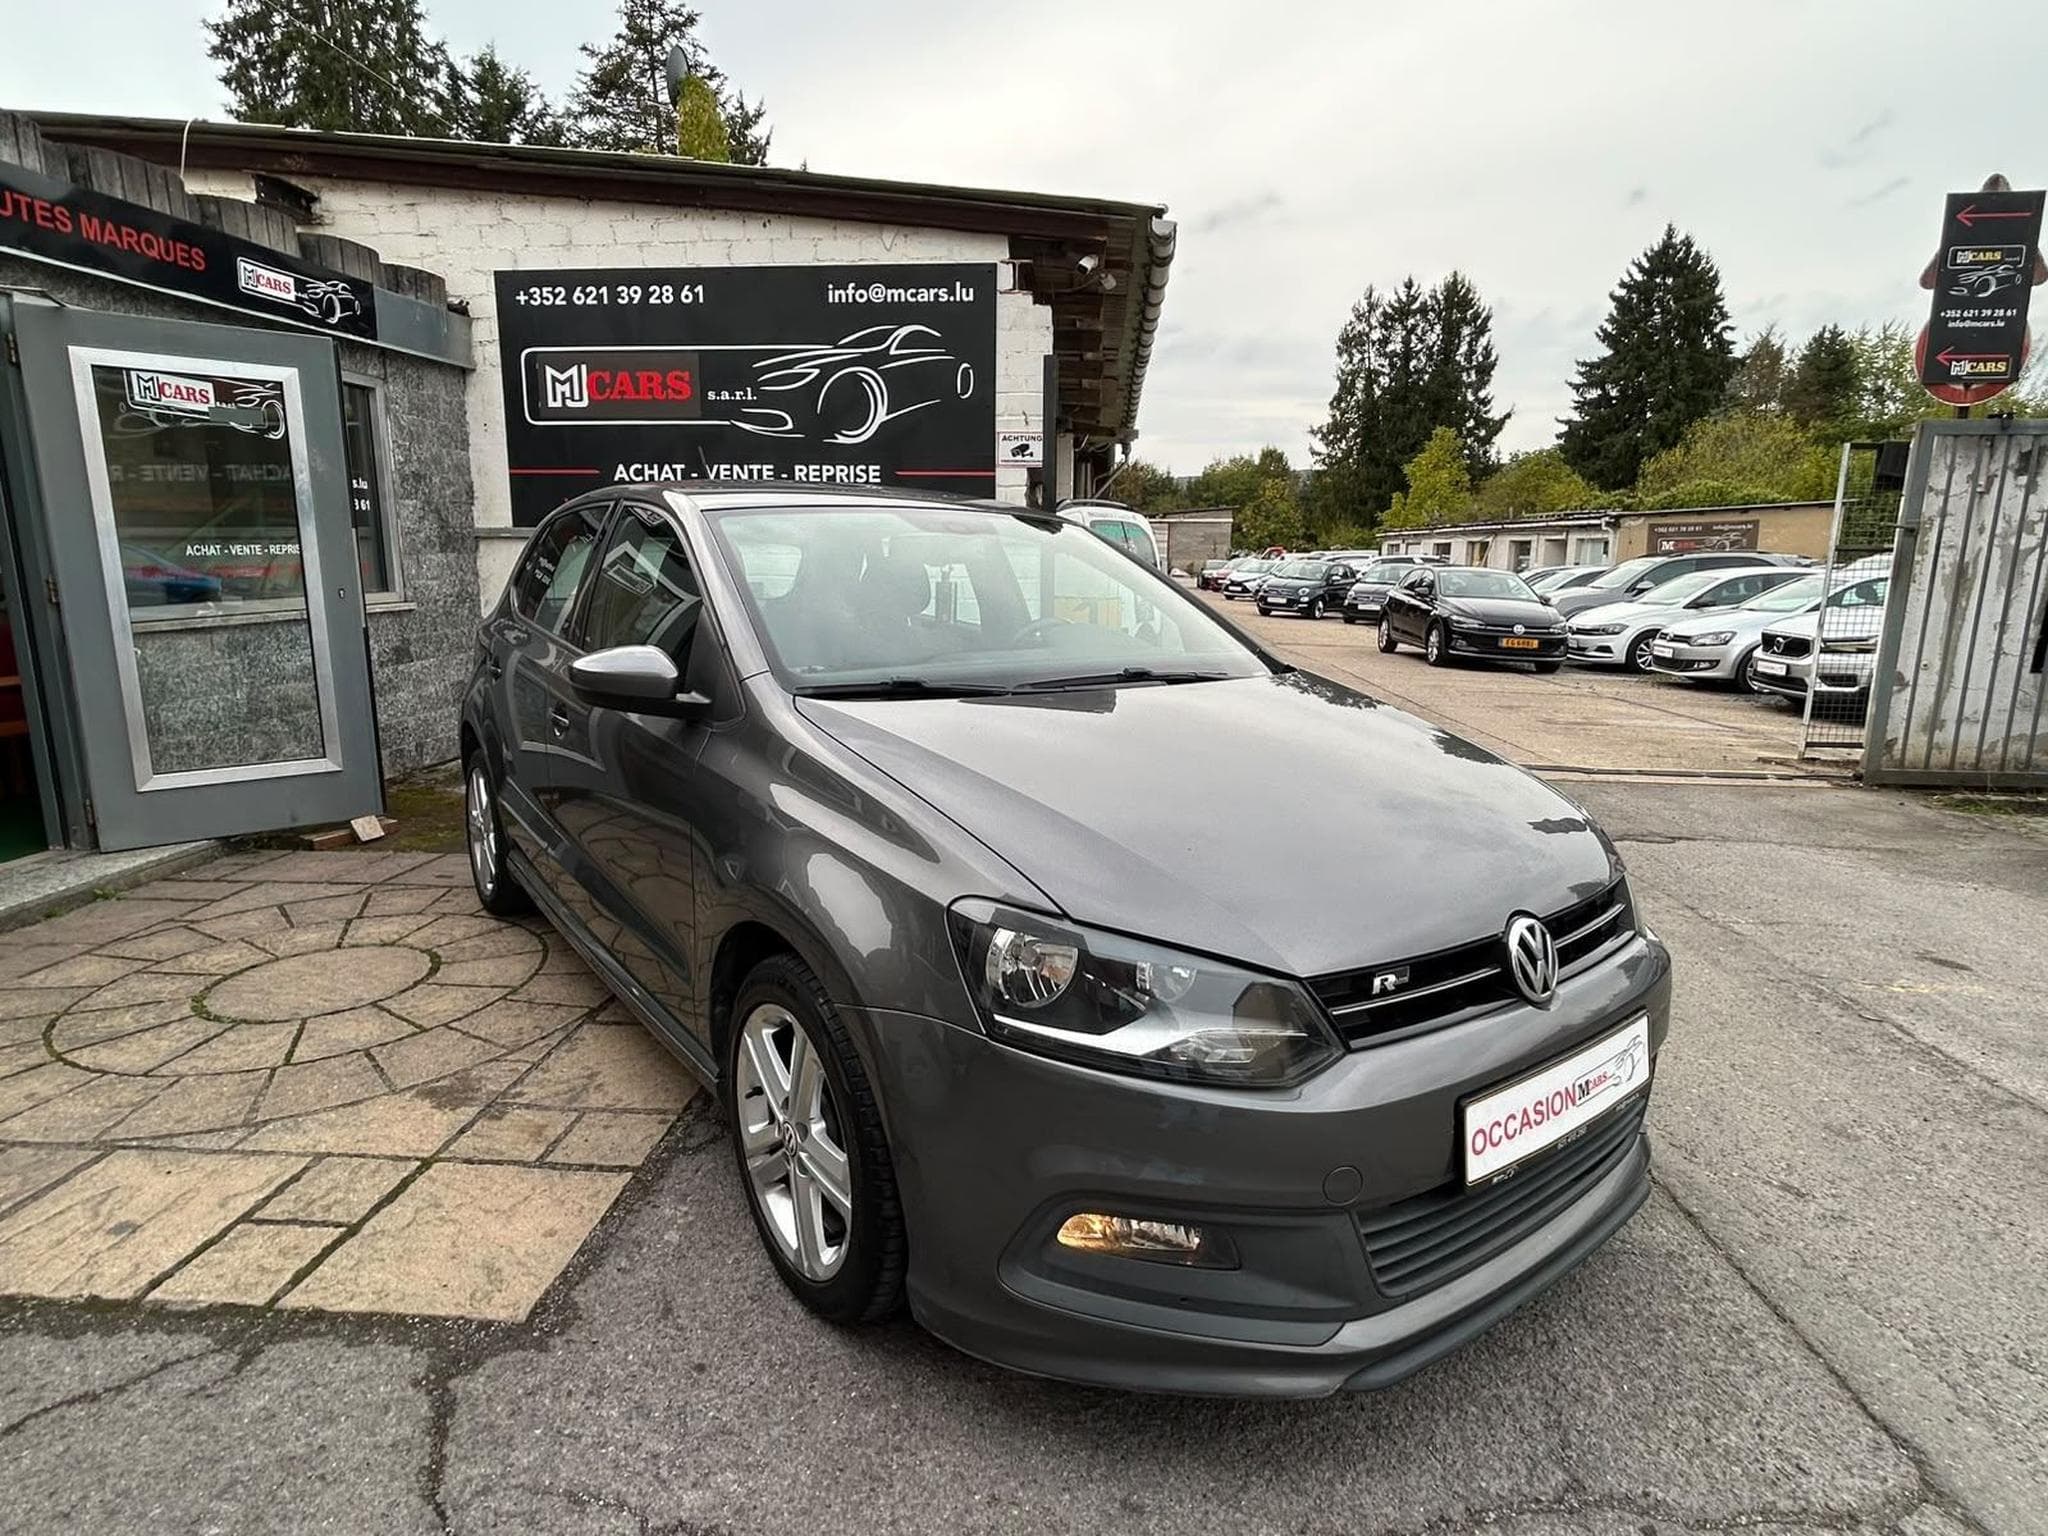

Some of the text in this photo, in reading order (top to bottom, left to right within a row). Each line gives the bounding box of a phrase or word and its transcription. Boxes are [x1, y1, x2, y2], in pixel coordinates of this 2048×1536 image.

[0, 190, 206, 271] UTES MARQUES
[516, 284, 705, 306] +352 621 39 28 61
[828, 281, 974, 303] info@mcars.lu
[1981, 309, 1992, 317] 39
[2006, 308, 2017, 316] 61
[707, 387, 757, 401] s.a.r.l.
[1001, 434, 1043, 442] ACHTUNG
[613, 463, 685, 482] ACHAT
[706, 463, 775, 481] VENTE
[794, 464, 881, 483] REPRISE
[185, 544, 221, 556] ACHAT
[229, 544, 262, 555] VENTE
[269, 544, 300, 555] REPRIS
[1471, 1083, 1577, 1156] OCCASION
